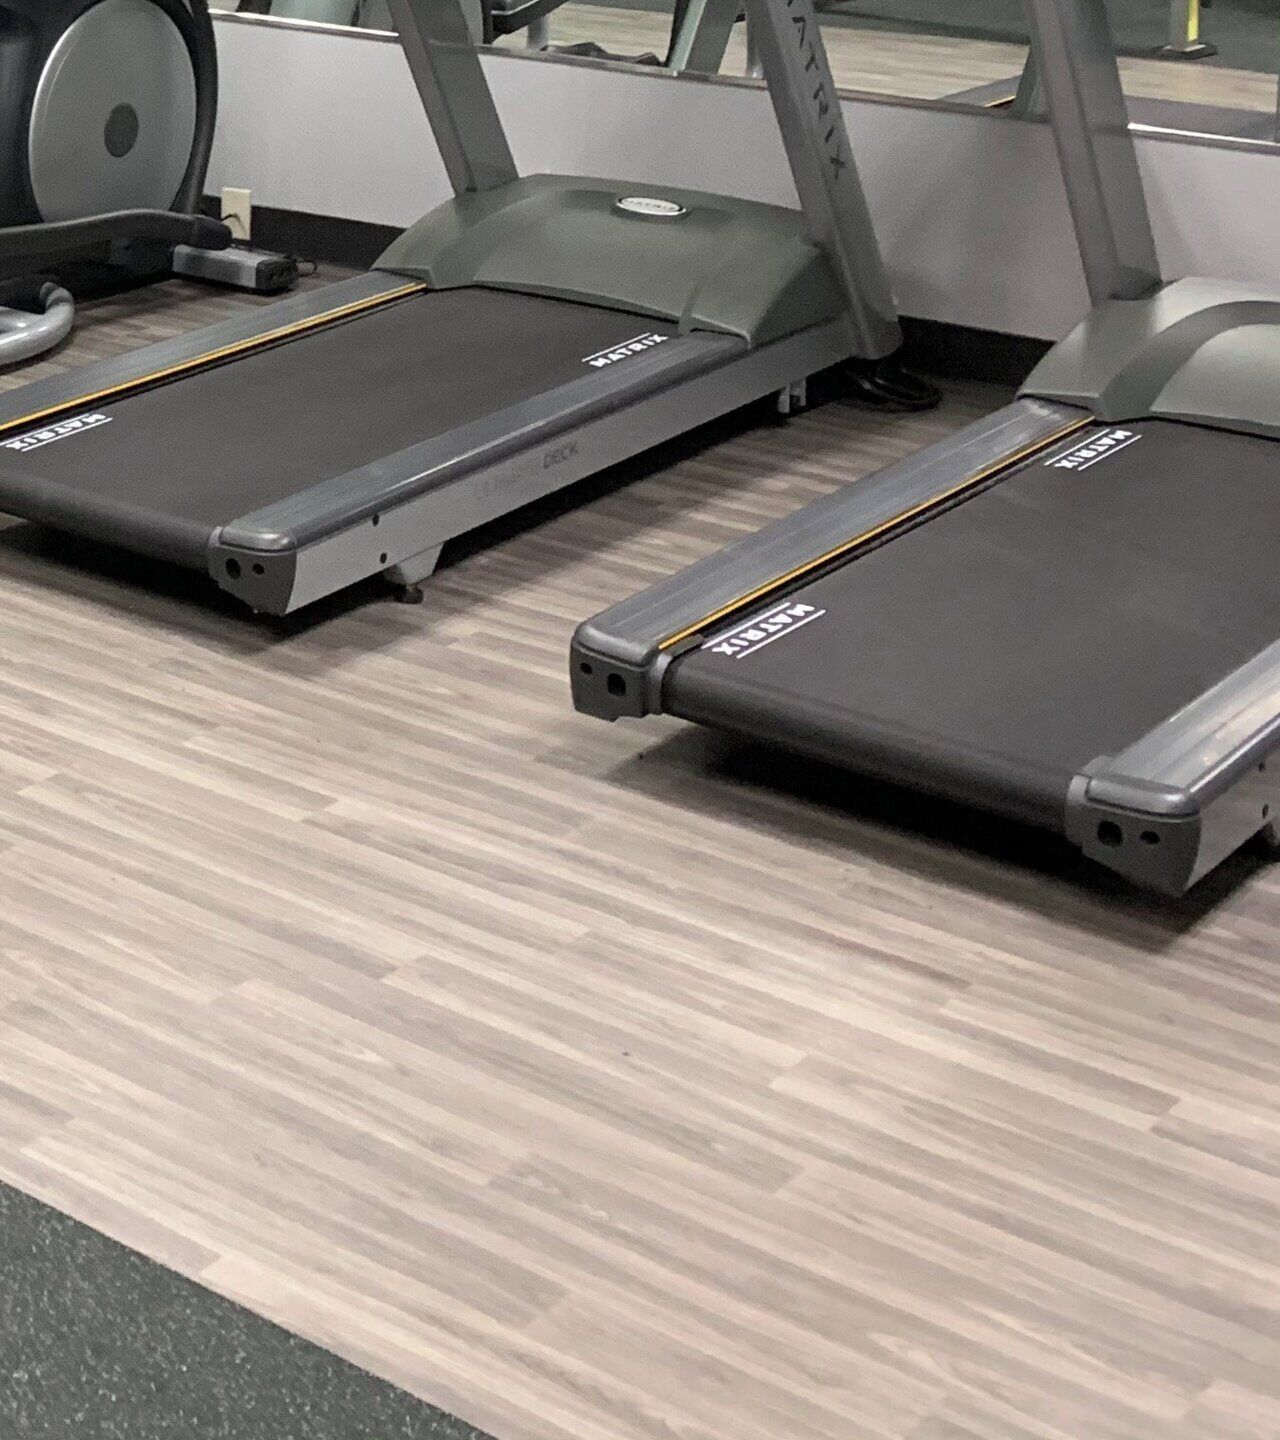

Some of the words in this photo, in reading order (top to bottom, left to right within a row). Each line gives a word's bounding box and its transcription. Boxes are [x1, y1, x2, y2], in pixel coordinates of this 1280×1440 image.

[589, 334, 669, 367] MATRIX
[5, 413, 107, 450] MATRIX
[1053, 429, 1133, 469] MATRIX
[711, 603, 816, 656] MATRIX
